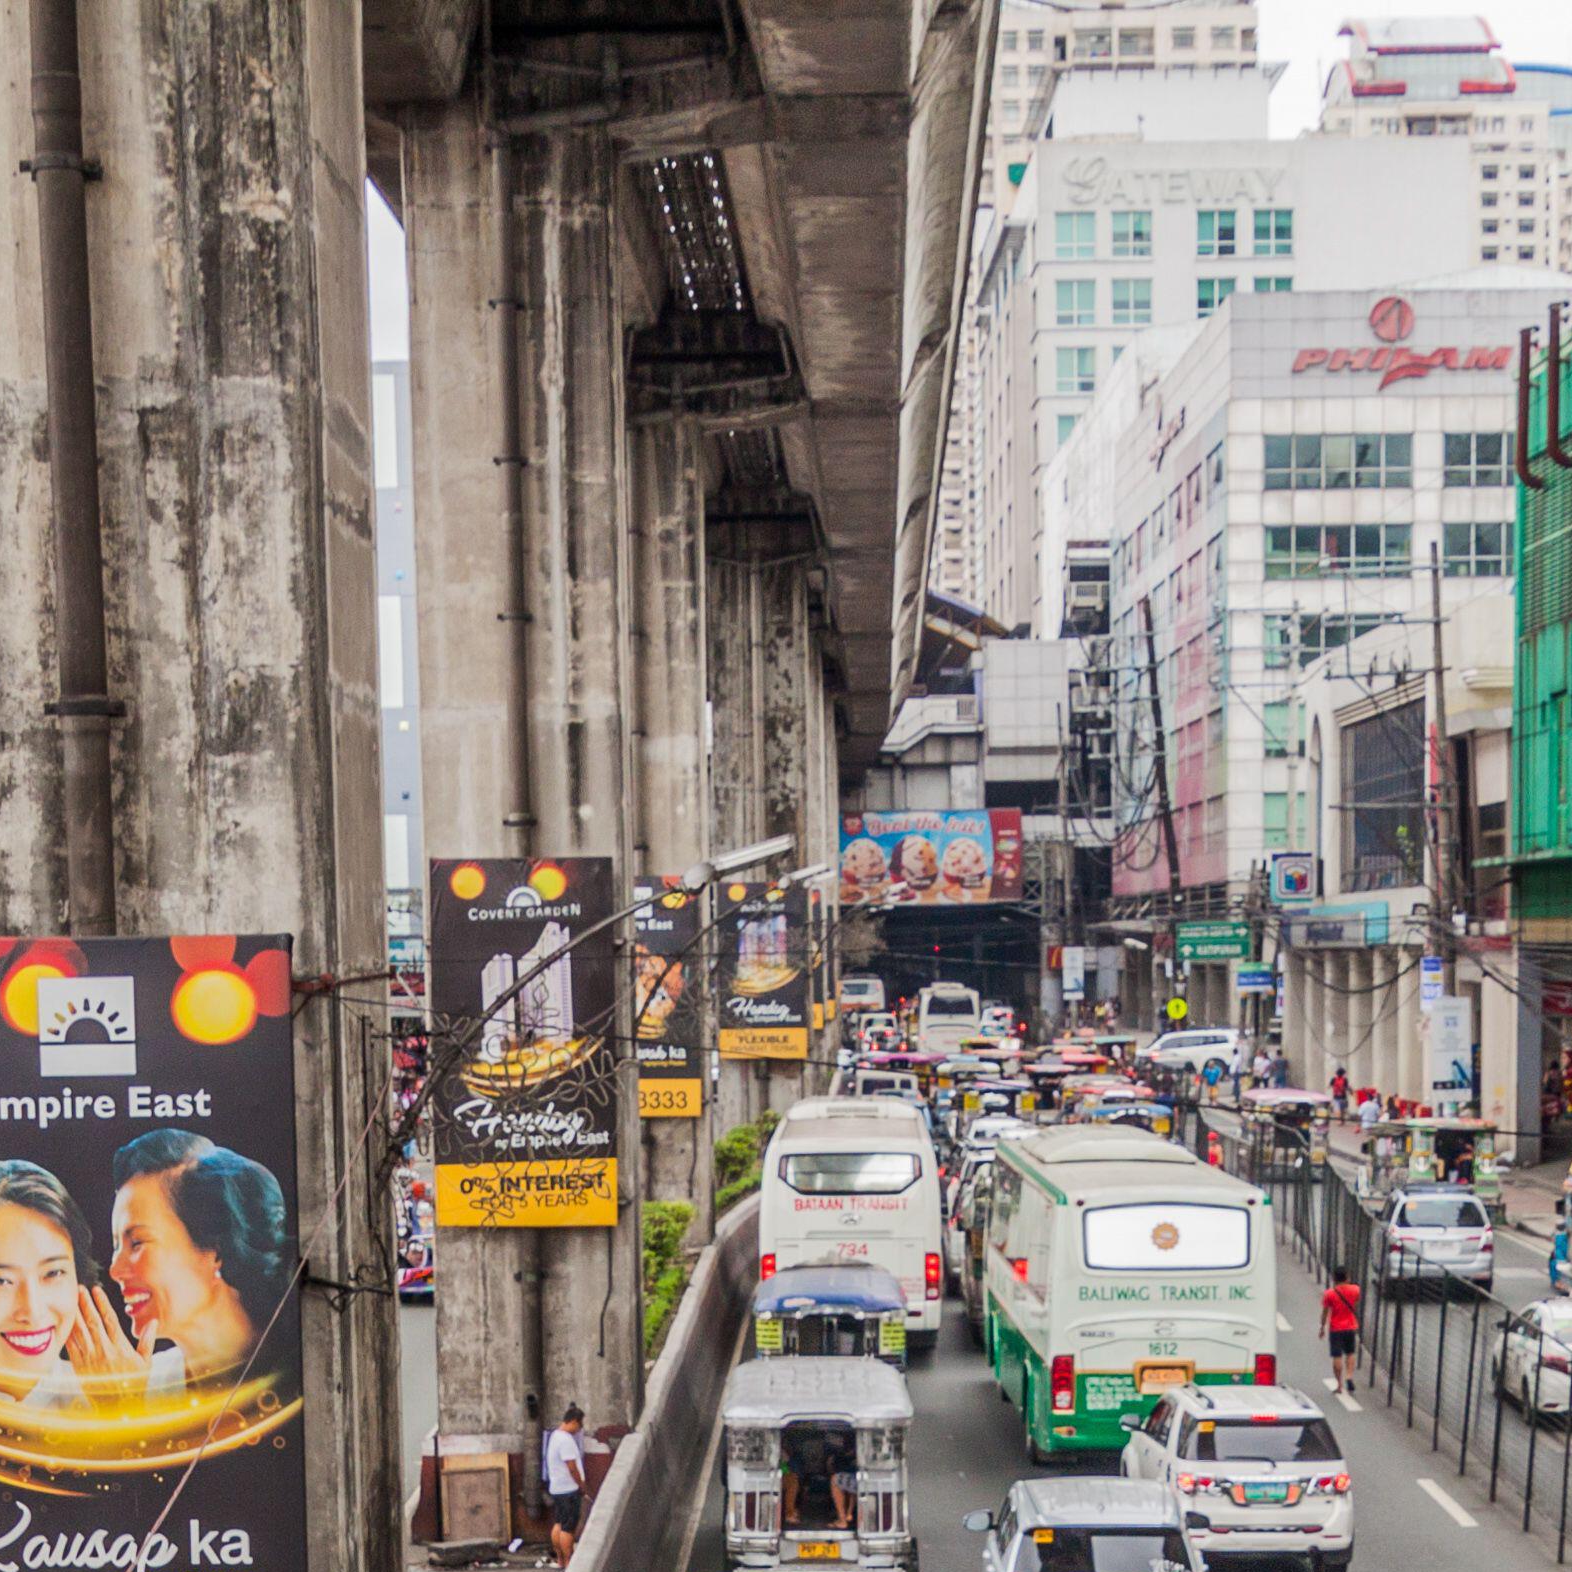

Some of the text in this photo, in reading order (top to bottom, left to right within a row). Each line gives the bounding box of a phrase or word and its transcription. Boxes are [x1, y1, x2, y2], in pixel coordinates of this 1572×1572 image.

[1062, 155, 1287, 206] GATEWAY
[1291, 346, 1515, 391] PHILAM
[468, 903, 581, 921] COVENT GARDEN
[128, 1085, 212, 1117] East
[499, 1172, 606, 1193] INTEREST
[533, 1191, 588, 1208] YEARS
[794, 1198, 908, 1213] BATAAN TRANSIT
[839, 1242, 870, 1257] 734
[1078, 1286, 1150, 1303] BALIWAG
[1147, 1342, 1179, 1357] 1612
[190, 1519, 254, 1567] ka
